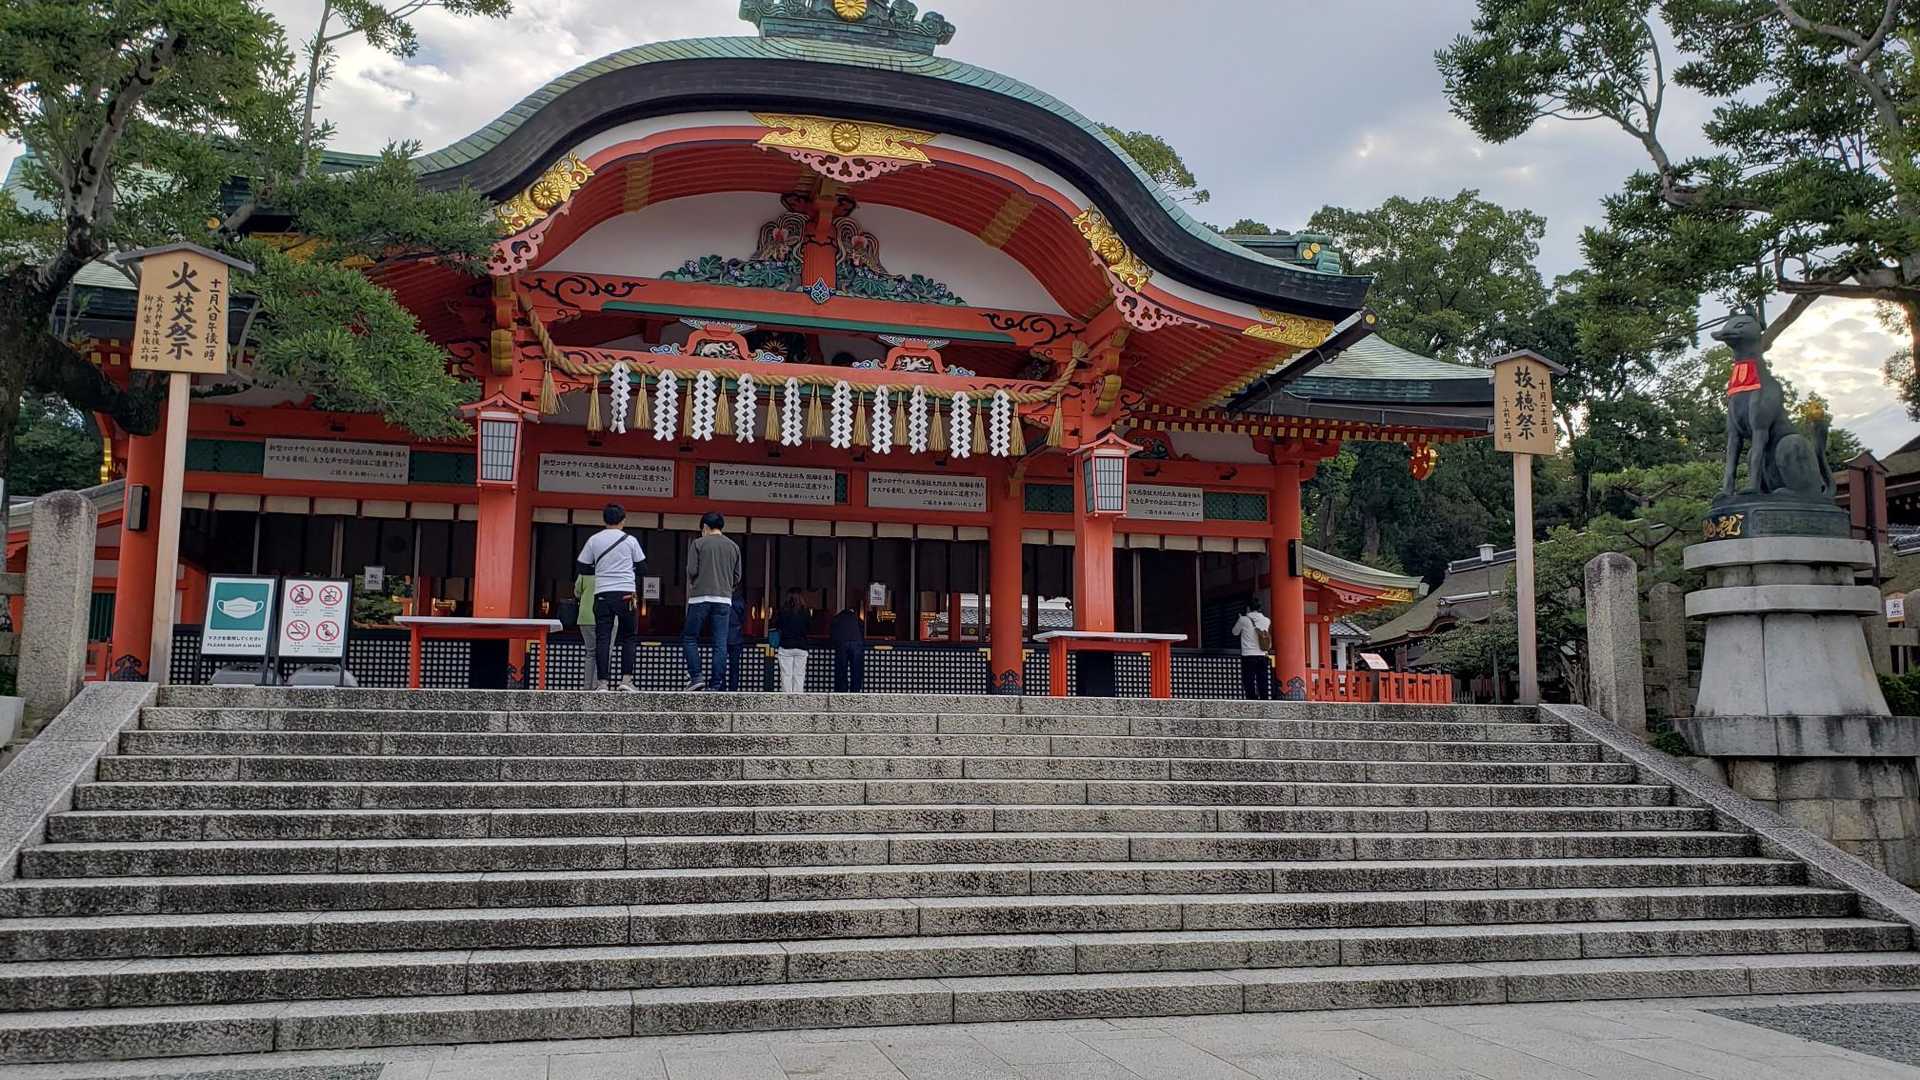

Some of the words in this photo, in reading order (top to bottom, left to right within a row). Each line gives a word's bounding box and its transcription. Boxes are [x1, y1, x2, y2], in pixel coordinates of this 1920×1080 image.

[165, 261, 202, 360] 火焚祭
[204, 278, 221, 361] 十一月八日午後一時
[1539, 379, 1549, 434] 十月二十五日
